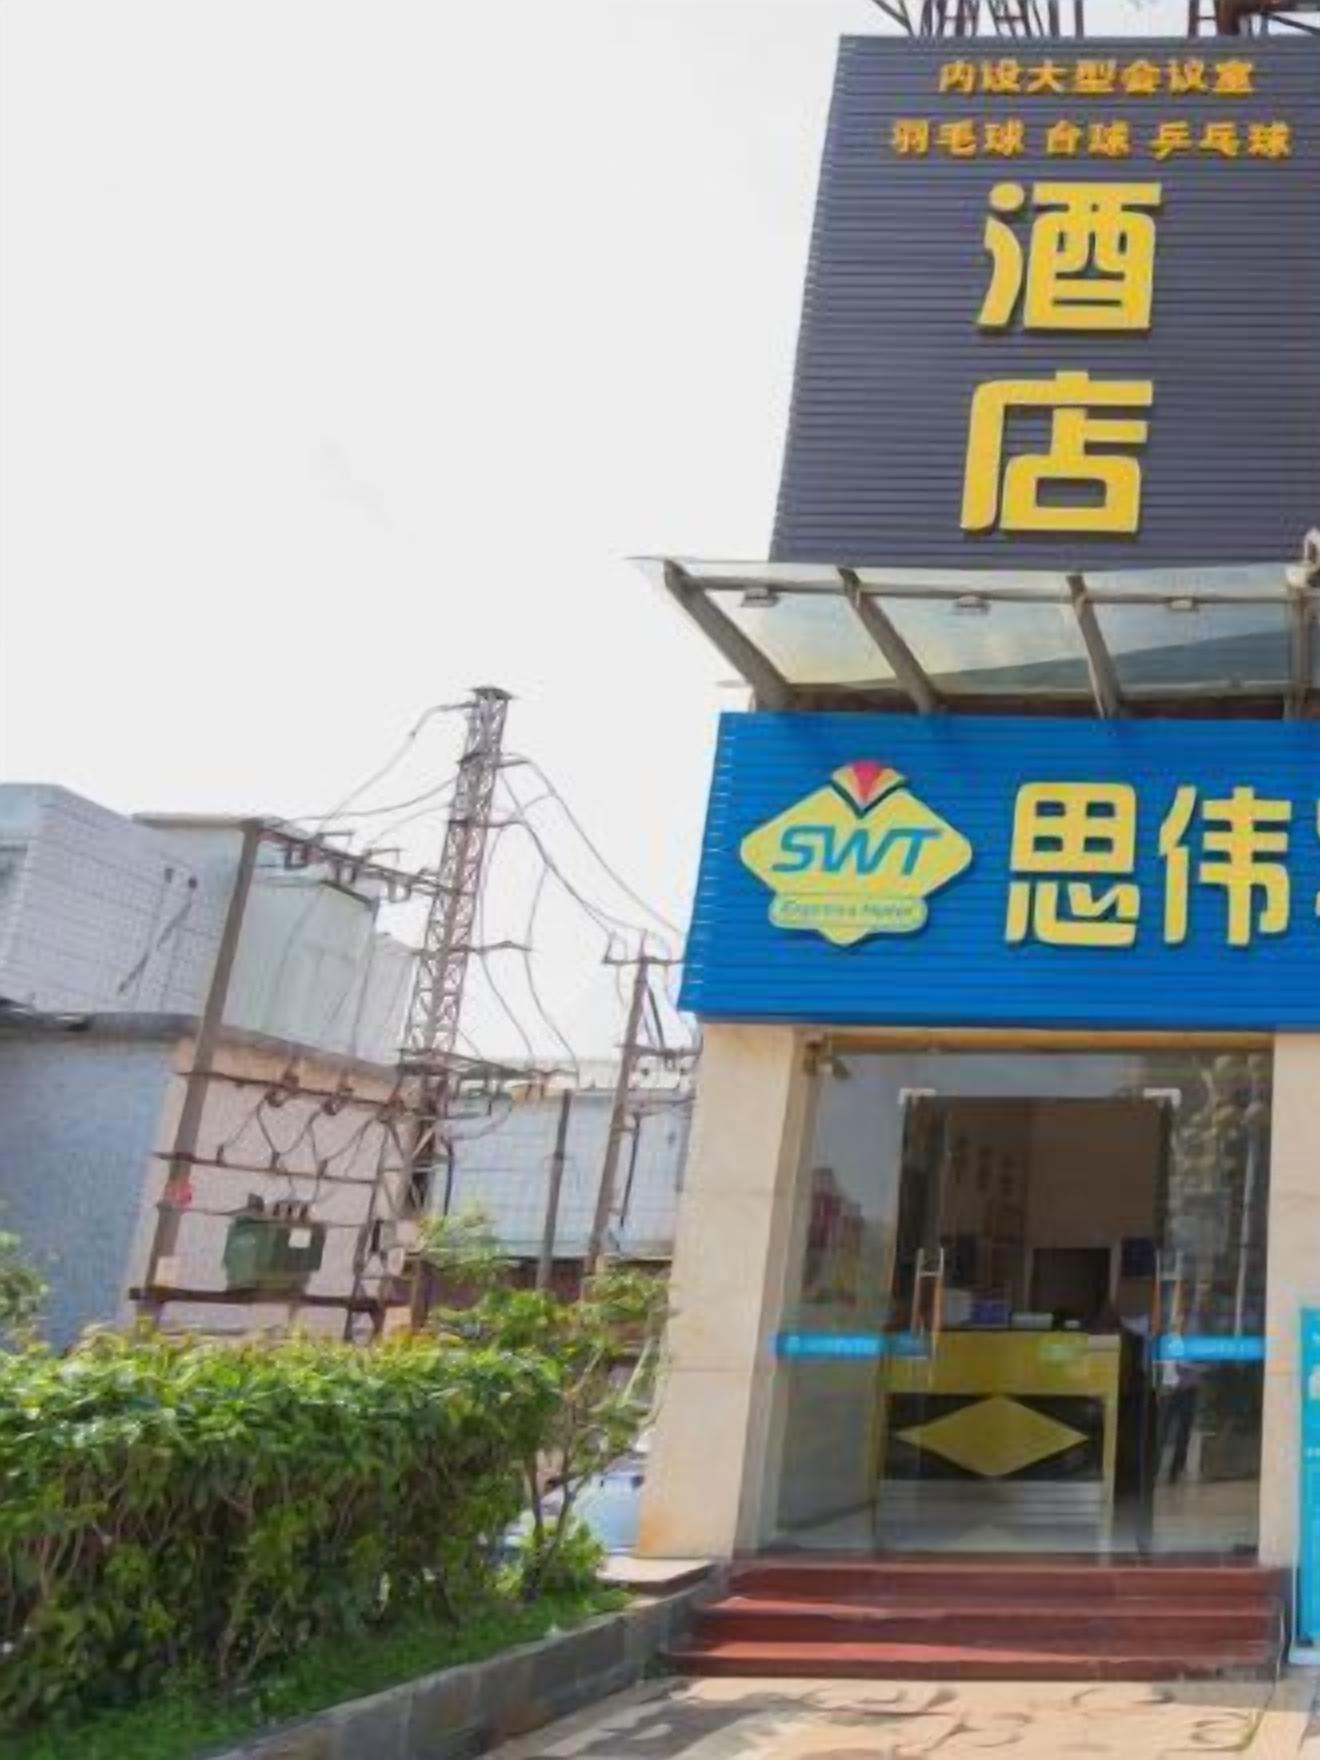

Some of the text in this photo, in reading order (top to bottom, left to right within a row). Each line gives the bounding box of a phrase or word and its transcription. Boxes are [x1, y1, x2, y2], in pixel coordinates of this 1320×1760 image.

[892, 119, 1291, 160] 羽毛球 台球 乒乓球
[961, 181, 1162, 533] 酒店
[772, 824, 942, 876] SWT
